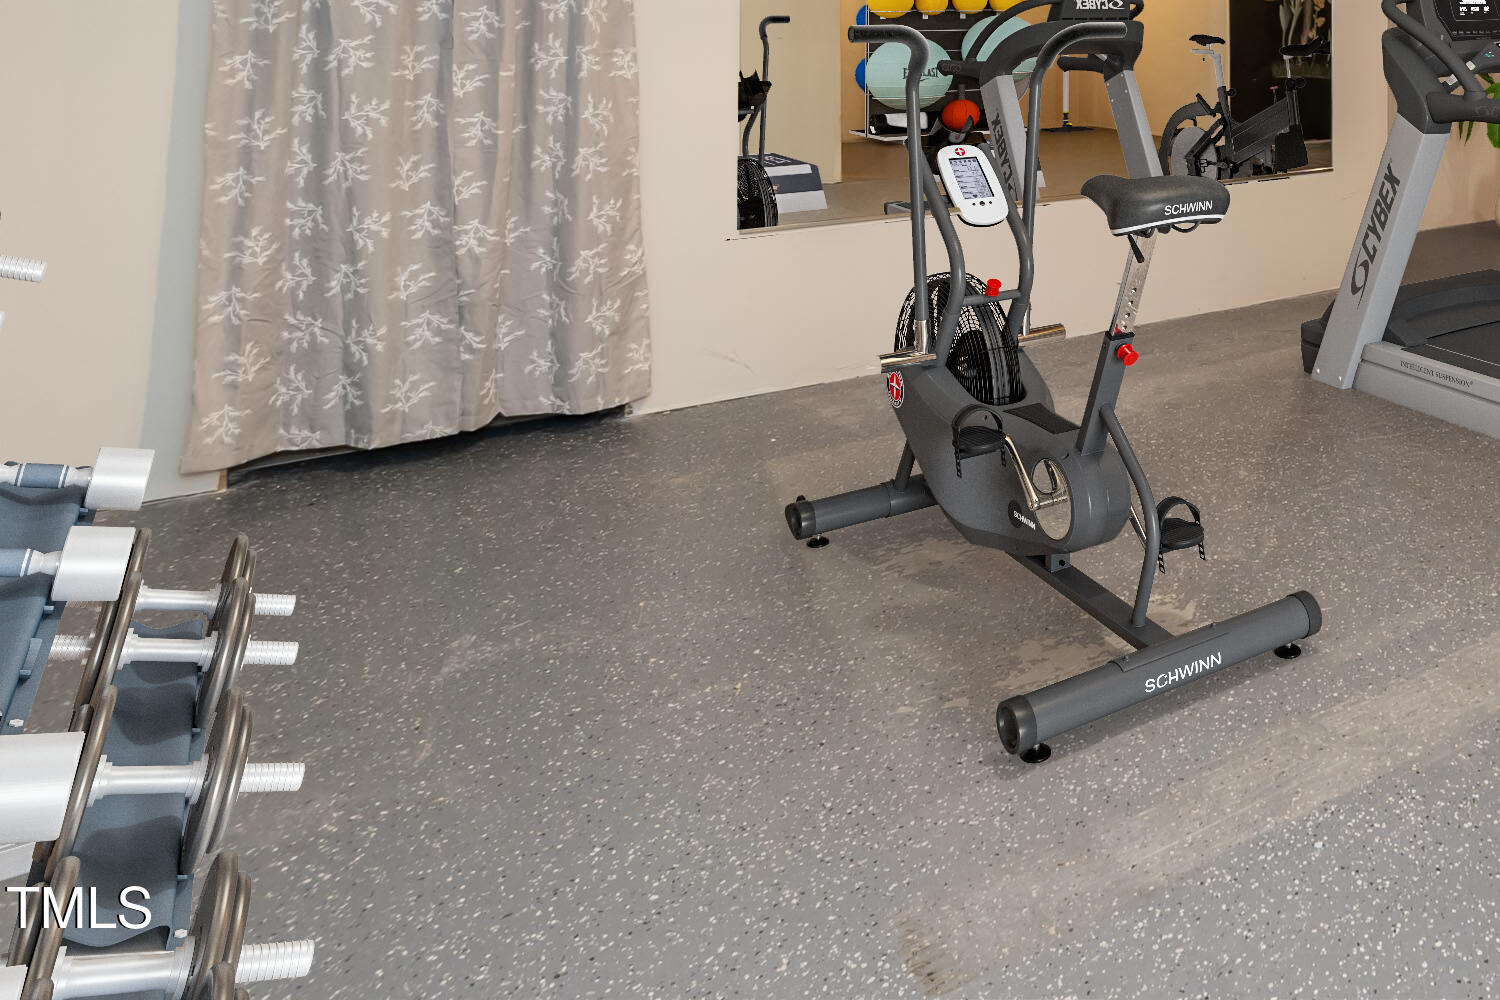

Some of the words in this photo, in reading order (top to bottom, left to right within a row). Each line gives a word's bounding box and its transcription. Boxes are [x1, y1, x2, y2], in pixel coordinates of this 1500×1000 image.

[1164, 200, 1213, 216] SCHWINN
[1361, 162, 1401, 265] CYBEX
[1400, 360, 1435, 377] INTELLIGENT
[1013, 510, 1036, 531] SCHWINN
[1144, 651, 1222, 693] SCHWINN
